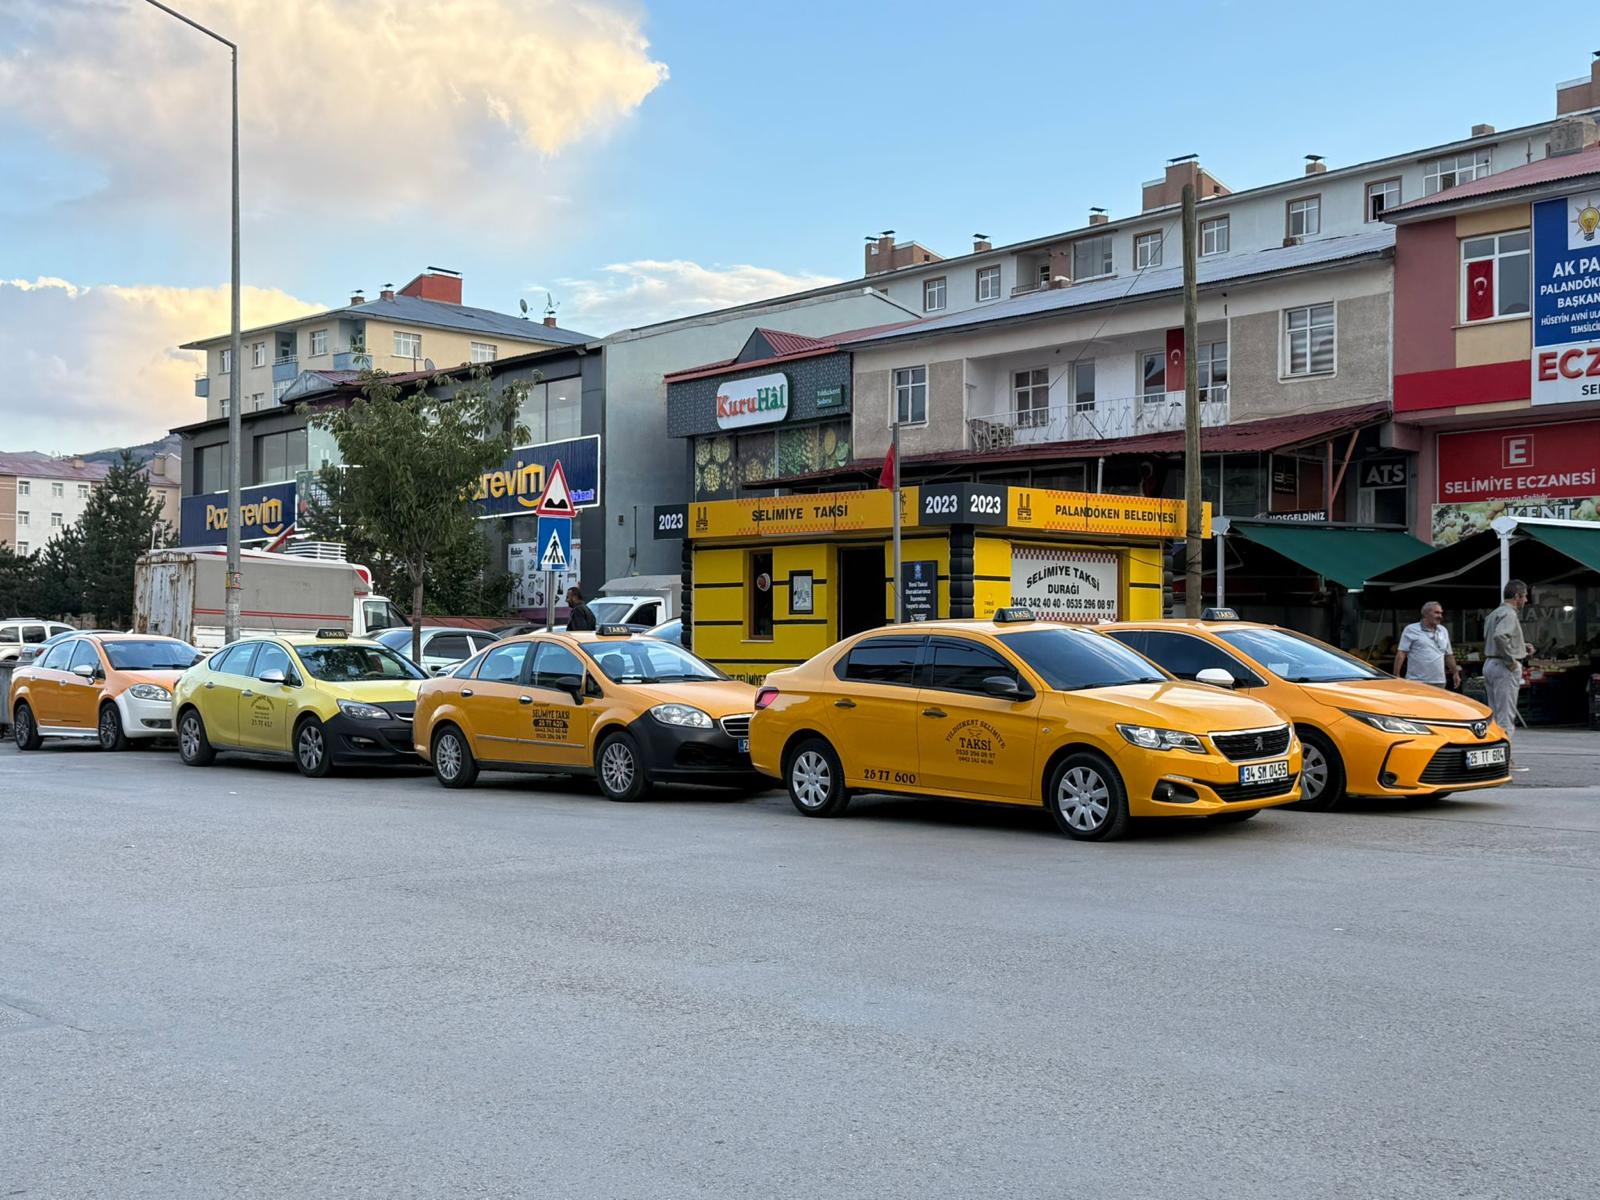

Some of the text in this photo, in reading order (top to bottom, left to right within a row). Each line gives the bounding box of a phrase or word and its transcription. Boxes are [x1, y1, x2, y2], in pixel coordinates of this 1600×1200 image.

[1553, 260, 1576, 279] AK
[1541, 313, 1569, 326] HÜSEYİN
[1571, 309, 1588, 321] AVNİ
[1538, 347, 1600, 382] ECZ
[1581, 384, 1600, 396] SE
[1509, 439, 1527, 465] E
[1445, 468, 1596, 494] SELİMİYE ECZANESİ
[752, 501, 848, 522] SELİMİYE TAKSİ
[925, 495, 958, 514] 2023
[970, 494, 1001, 514] 2023
[206, 496, 283, 532] Pazrevim
[658, 513, 684, 530] 2023
[1055, 504, 1177, 524] PALANDÖKEN BELEDİYESİ
[1026, 563, 1100, 591] SELİMİYE TAKSİ
[1047, 582, 1080, 595] DURAĞI
[1010, 596, 1027, 608] 0442
[1028, 597, 1041, 608] 342
[1042, 598, 1051, 608] 40
[1052, 599, 1061, 608] 40
[1066, 599, 1082, 609] 0535
[1083, 600, 1095, 609] 296
[1097, 600, 1105, 610] 08
[1106, 600, 1115, 610] 97
[959, 737, 992, 751] TAKSİ
[1245, 767, 1255, 781] 34
[1268, 762, 1287, 778] 0455
